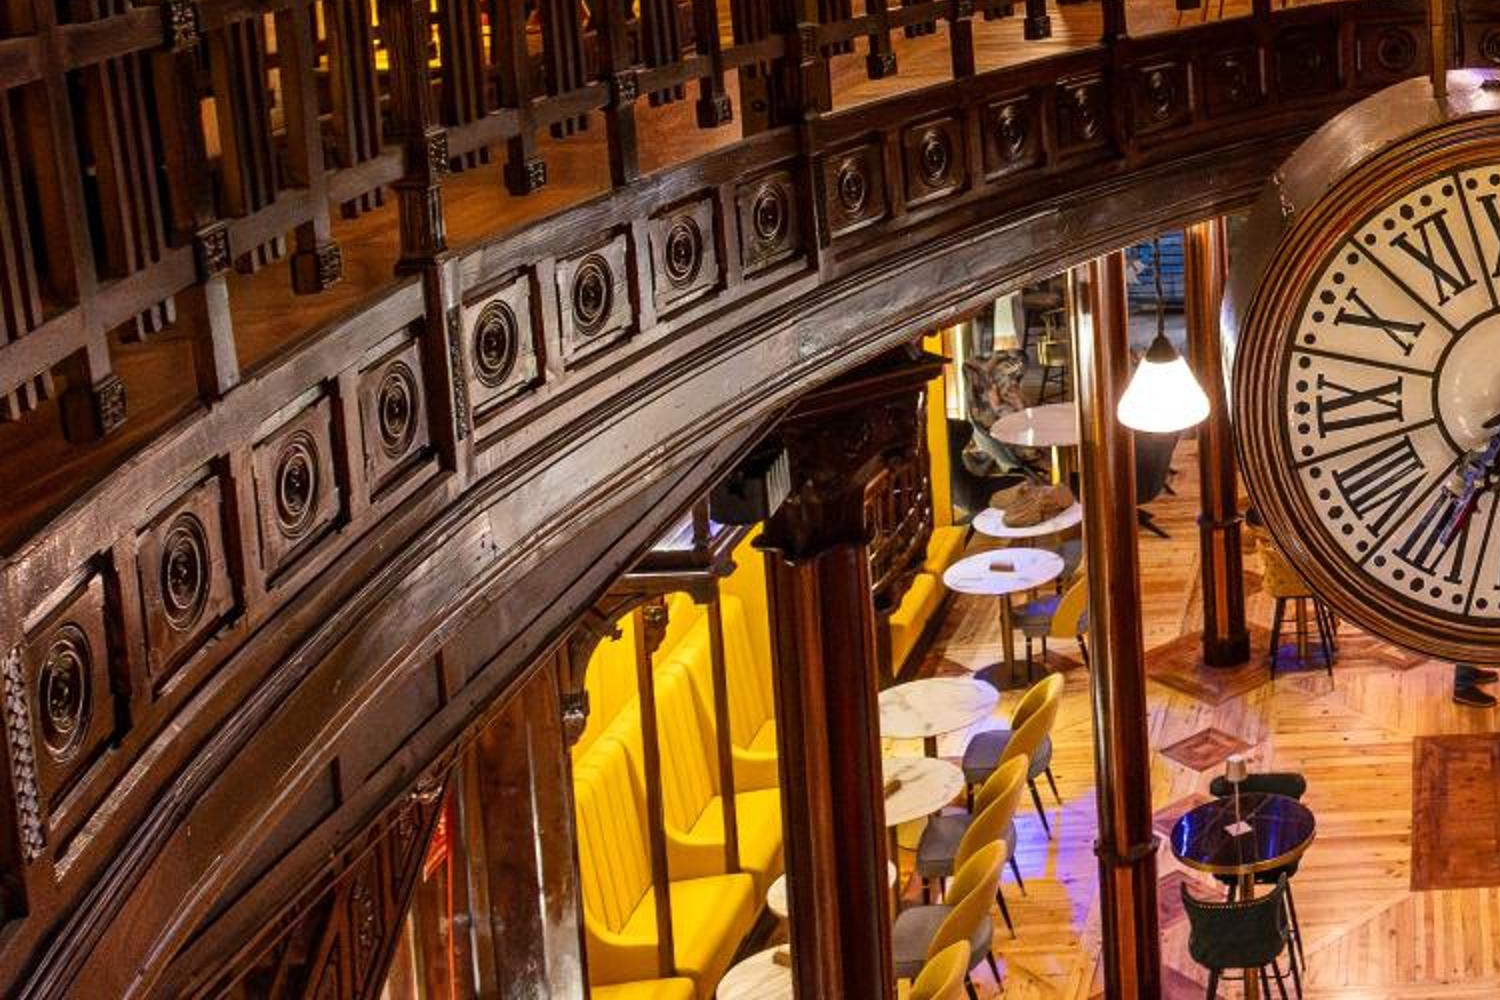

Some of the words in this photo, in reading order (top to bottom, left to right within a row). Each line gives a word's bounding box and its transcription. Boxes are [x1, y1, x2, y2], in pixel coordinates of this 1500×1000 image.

[1389, 207, 1477, 306] XI
[1334, 287, 1426, 357] X
[1316, 374, 1404, 439] IX
[1332, 434, 1429, 538] VIII
